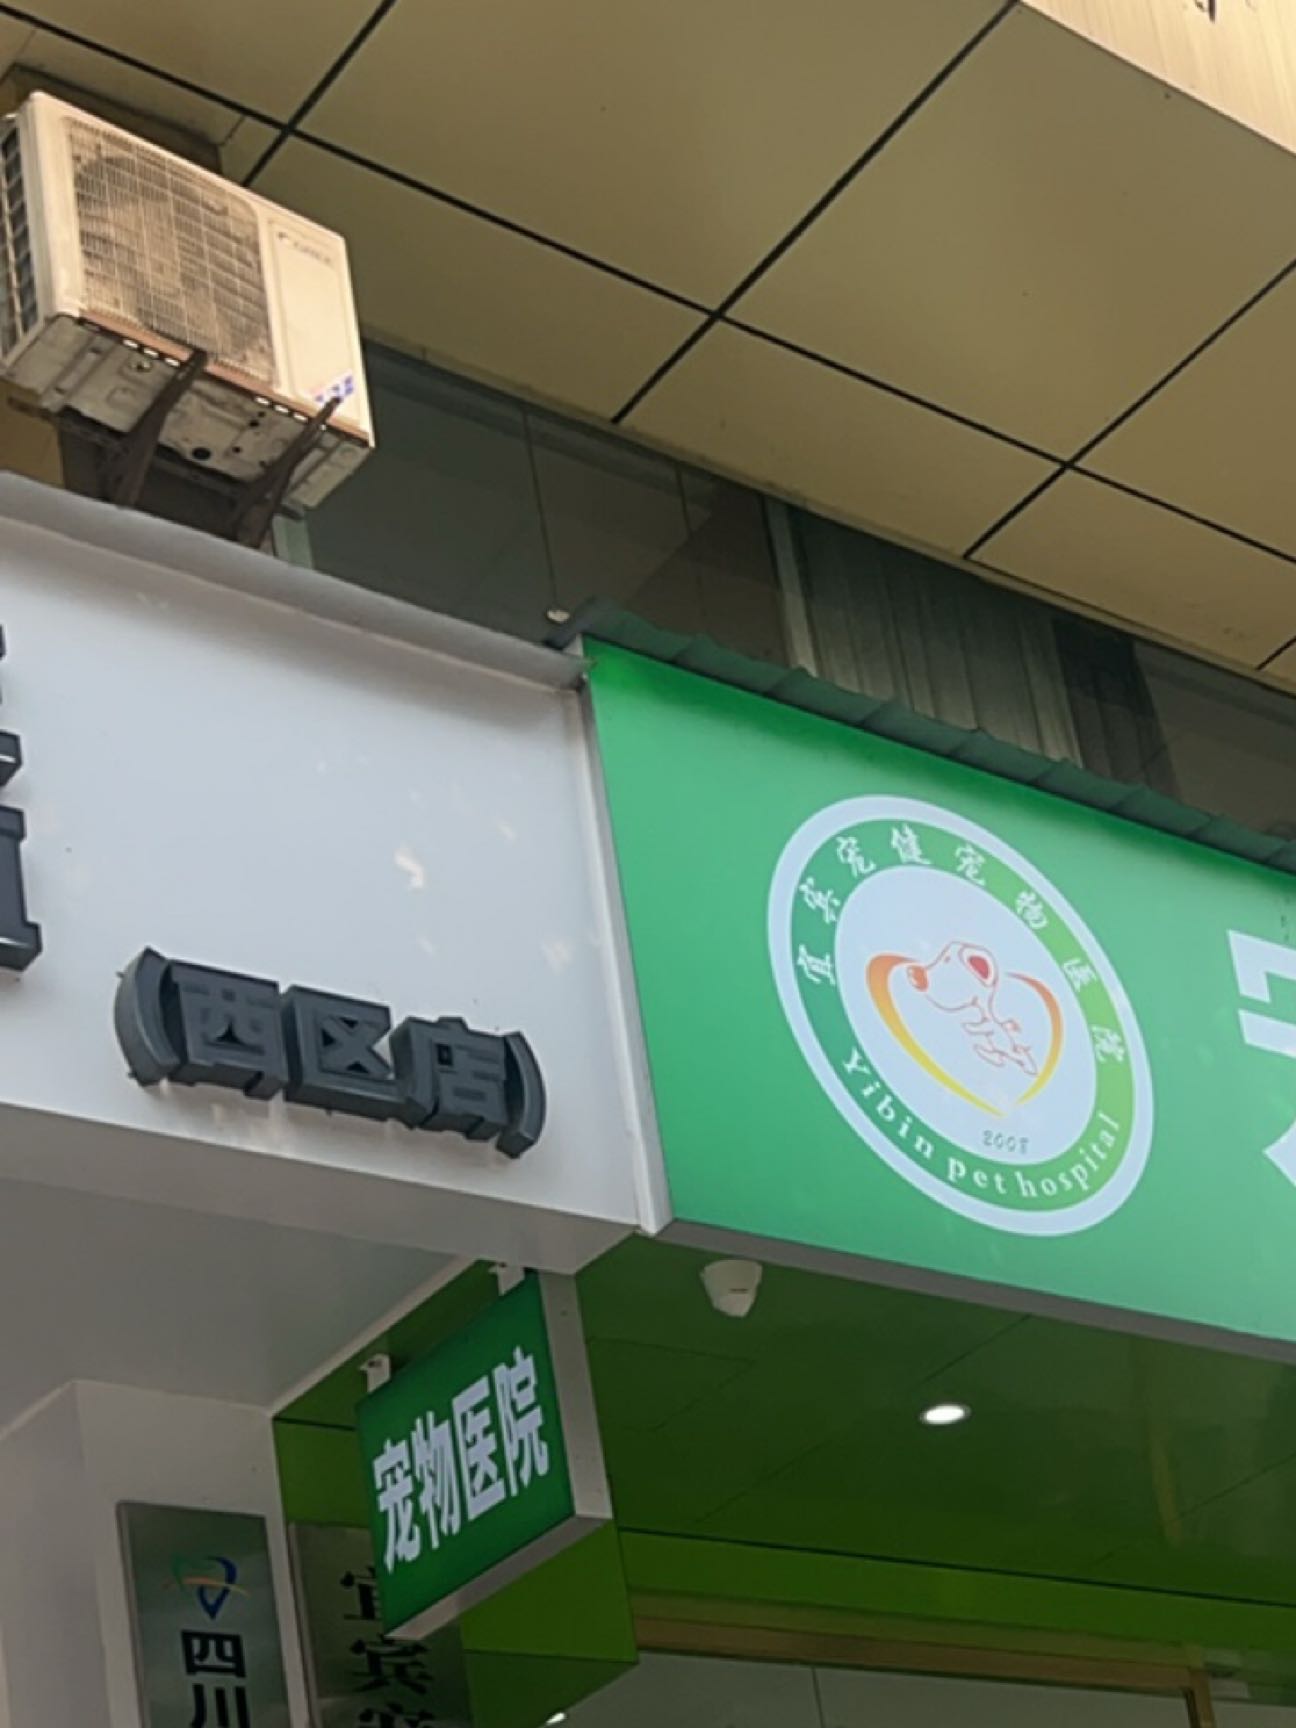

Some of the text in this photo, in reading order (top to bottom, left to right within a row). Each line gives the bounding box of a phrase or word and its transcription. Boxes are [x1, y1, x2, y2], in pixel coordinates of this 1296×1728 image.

[842, 1046, 935, 1160] Yibin
[1015, 1111, 1121, 1199] hospital
[372, 1345, 549, 1574] 宠物医院
